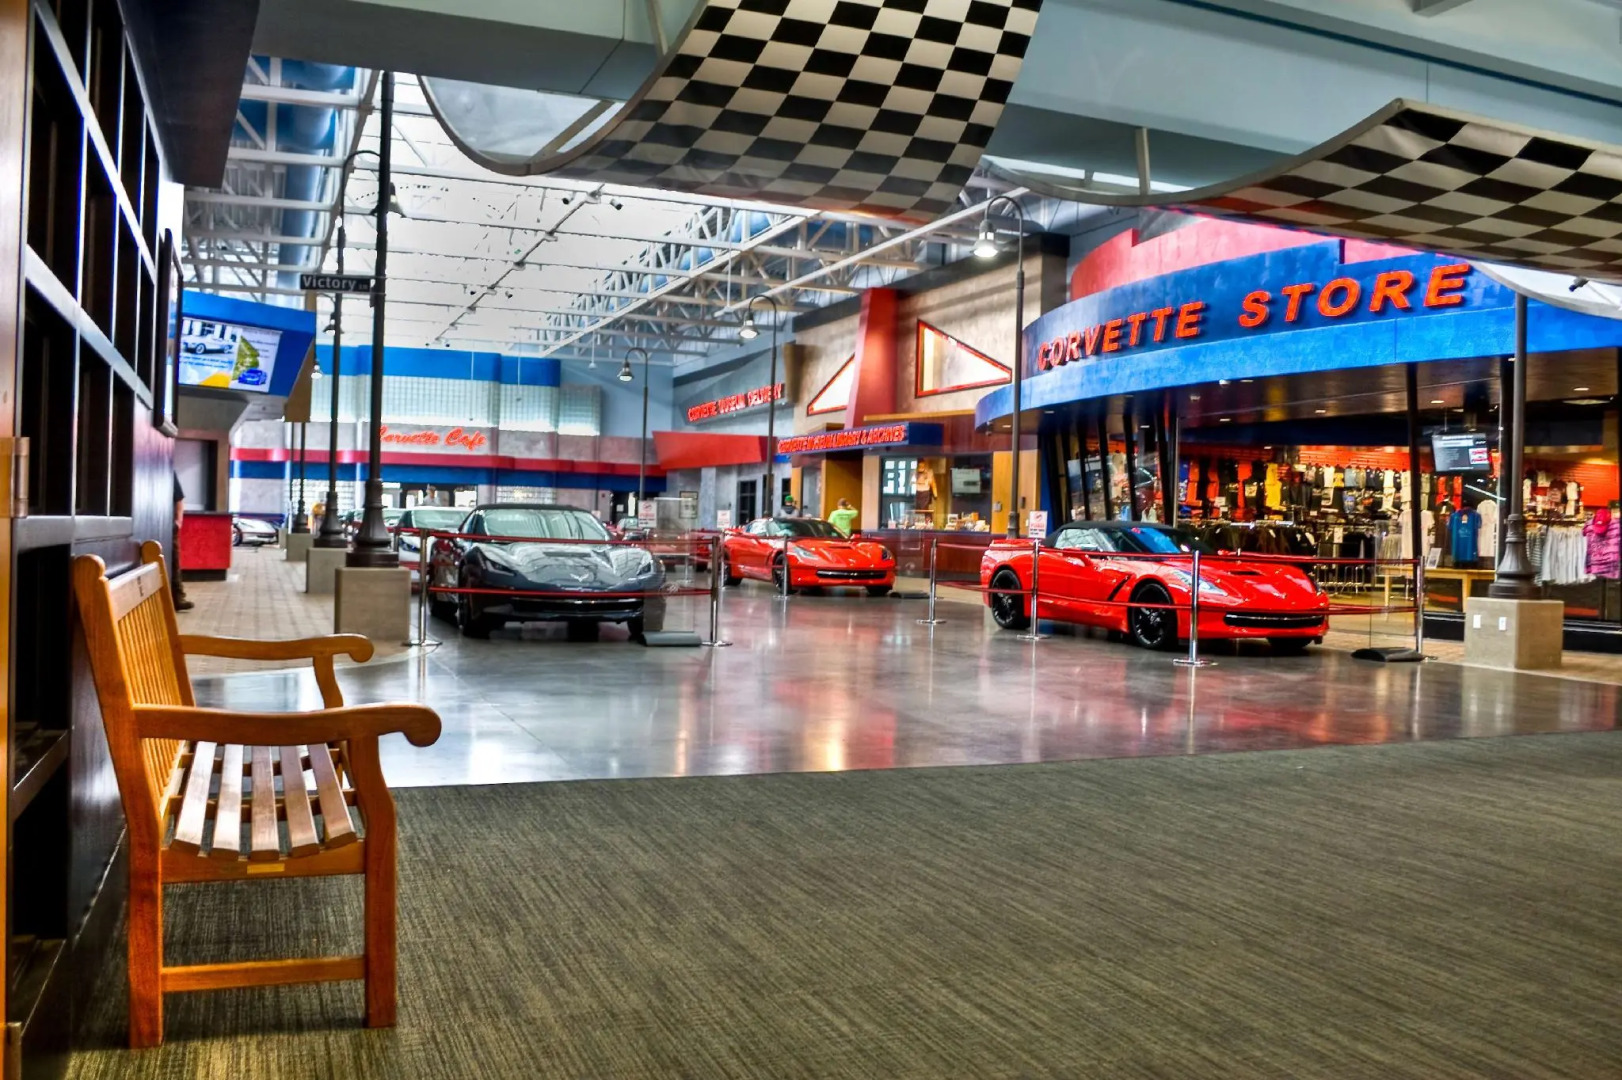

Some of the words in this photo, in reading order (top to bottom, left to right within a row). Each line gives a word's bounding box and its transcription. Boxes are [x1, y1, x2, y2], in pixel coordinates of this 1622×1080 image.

[302, 274, 357, 291] Victory
[1037, 301, 1205, 371] CORVETTE
[1238, 263, 1471, 328] STORE
[867, 424, 905, 444] ARCHIVES
